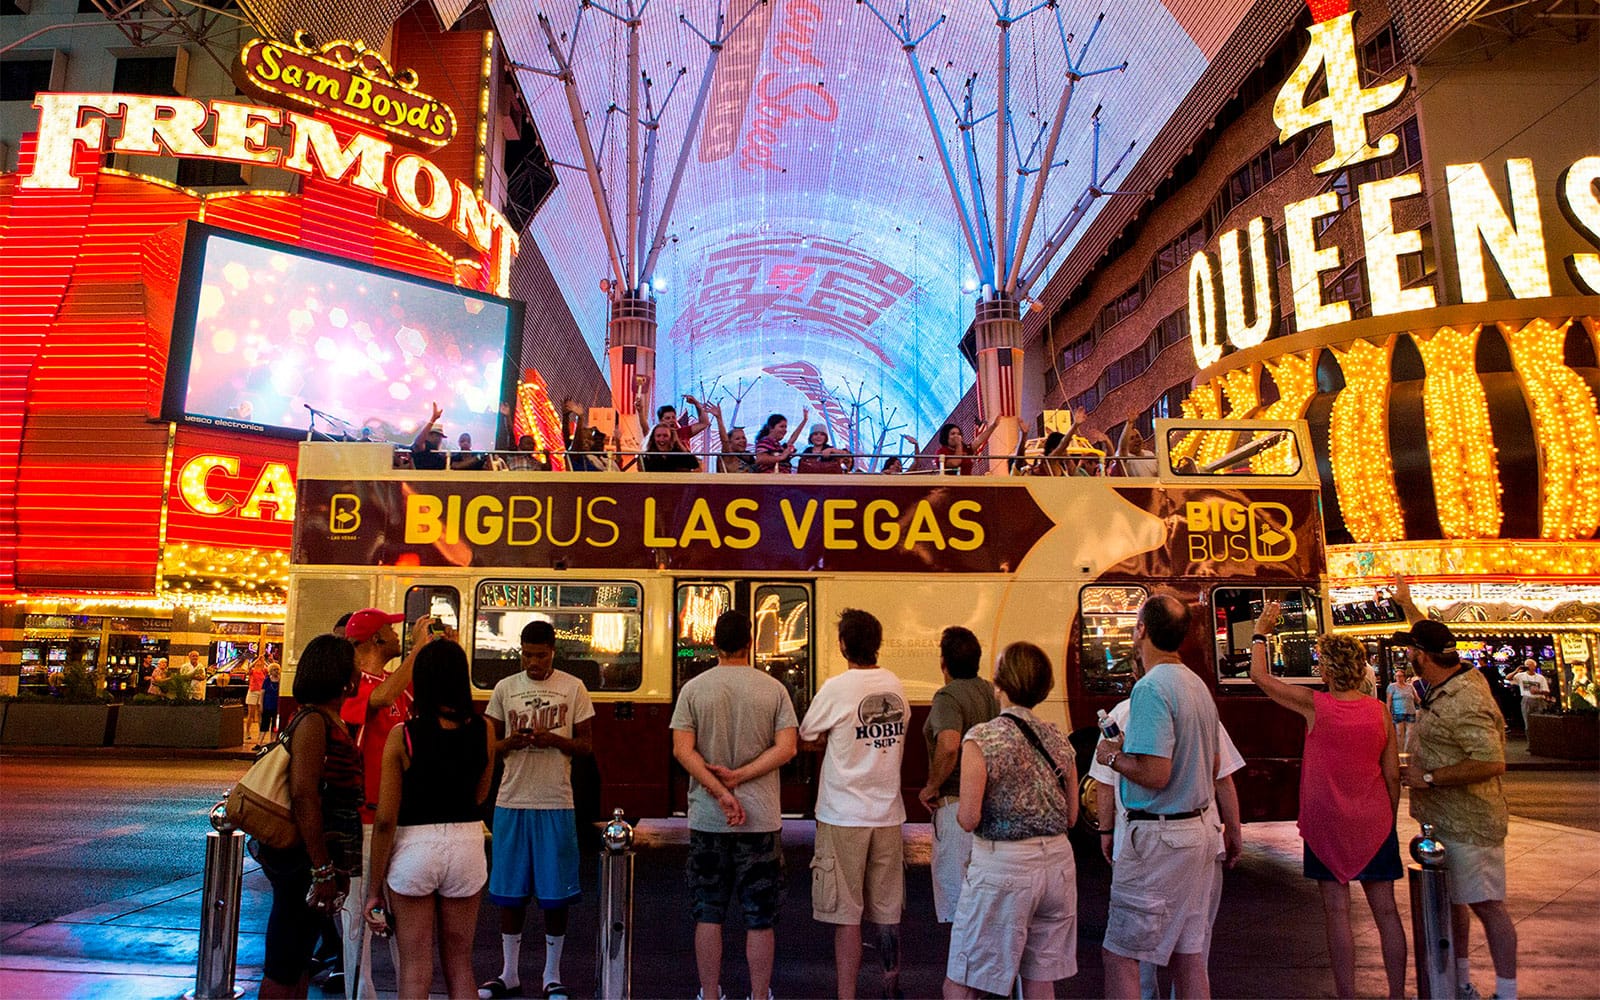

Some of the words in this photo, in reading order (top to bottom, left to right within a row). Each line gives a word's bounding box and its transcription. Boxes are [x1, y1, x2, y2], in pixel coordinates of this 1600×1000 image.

[255, 45, 341, 100] Sam
[344, 75, 447, 137] Boyd's
[1273, 10, 1409, 174] 4
[20, 91, 520, 299] FREMONT
[1188, 156, 1600, 369] QUEENS
[184, 415, 212, 424] yesco
[214, 419, 264, 431] electronics
[644, 497, 760, 549] LAS
[780, 498, 985, 551] VEGAS
[1186, 501, 1247, 532] BIG
[1188, 534, 1249, 562] BUS
[873, 737, 897, 749] SUP
